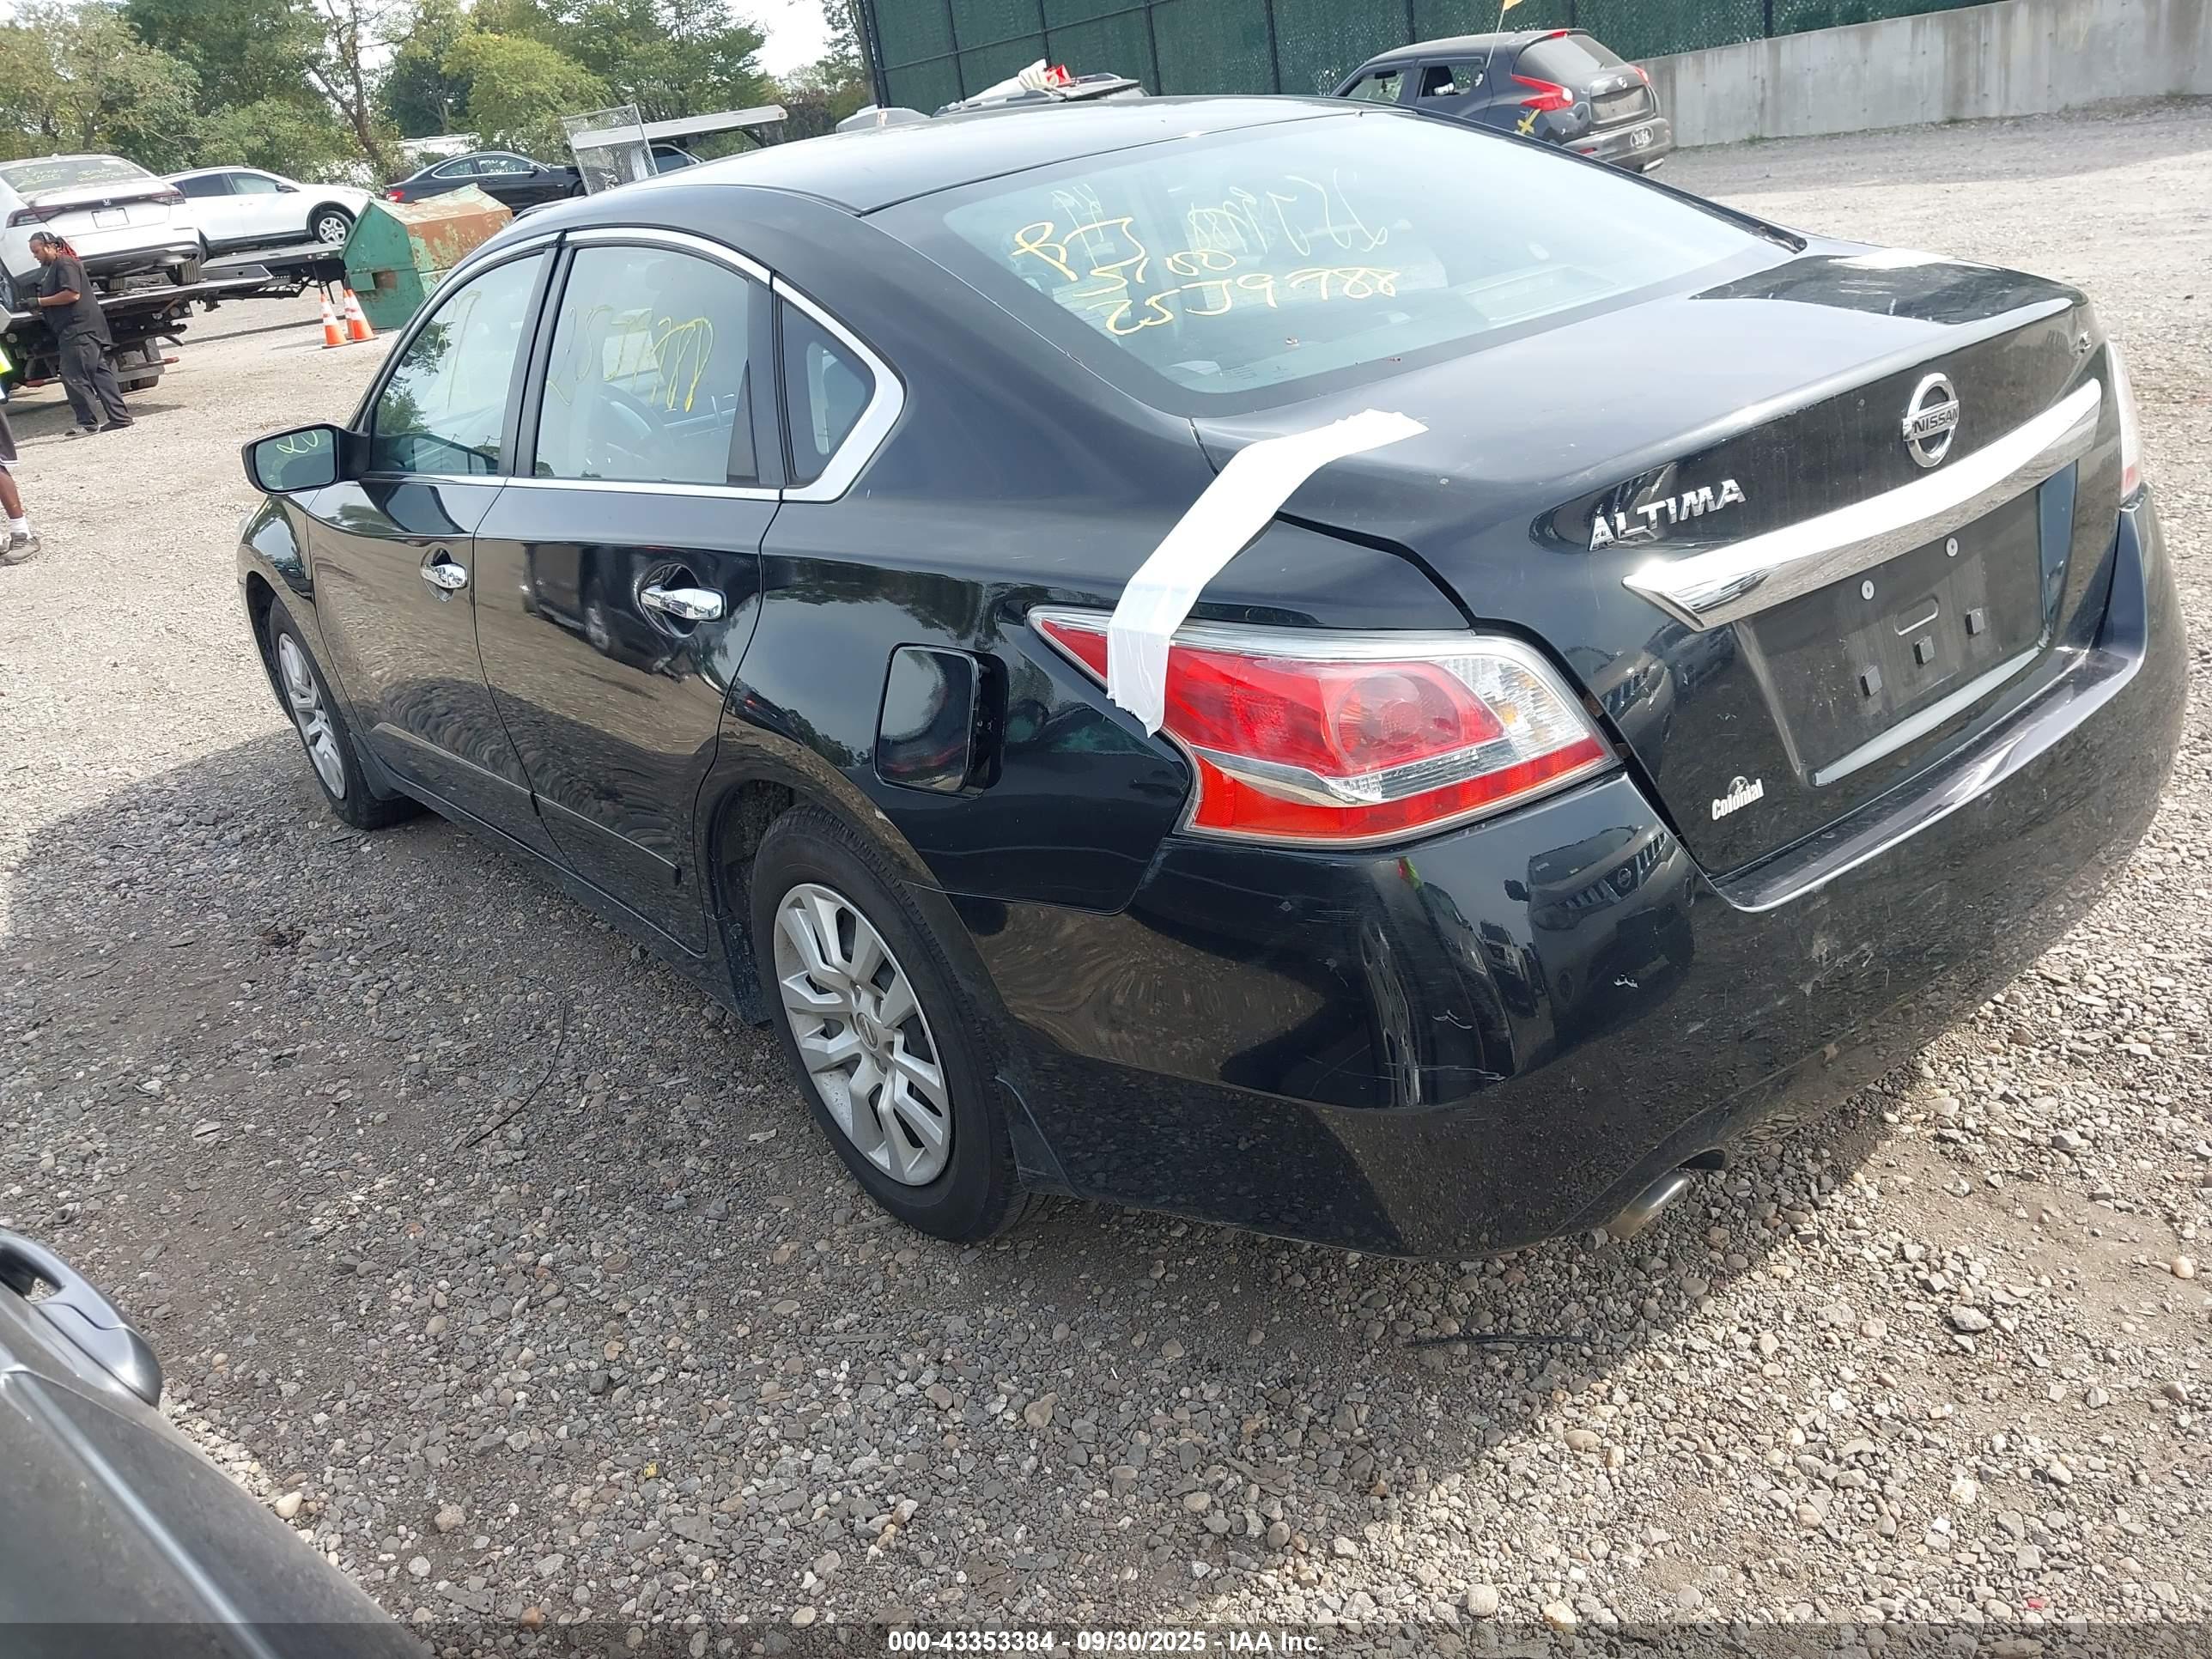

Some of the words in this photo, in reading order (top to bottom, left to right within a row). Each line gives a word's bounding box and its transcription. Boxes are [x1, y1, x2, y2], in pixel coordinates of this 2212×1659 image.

[1086, 266, 1401, 336] 25J9788
[1913, 406, 1959, 434] NISSAN
[1588, 478, 1747, 551] ALTIMA
[1711, 778, 1765, 821] Colonial
